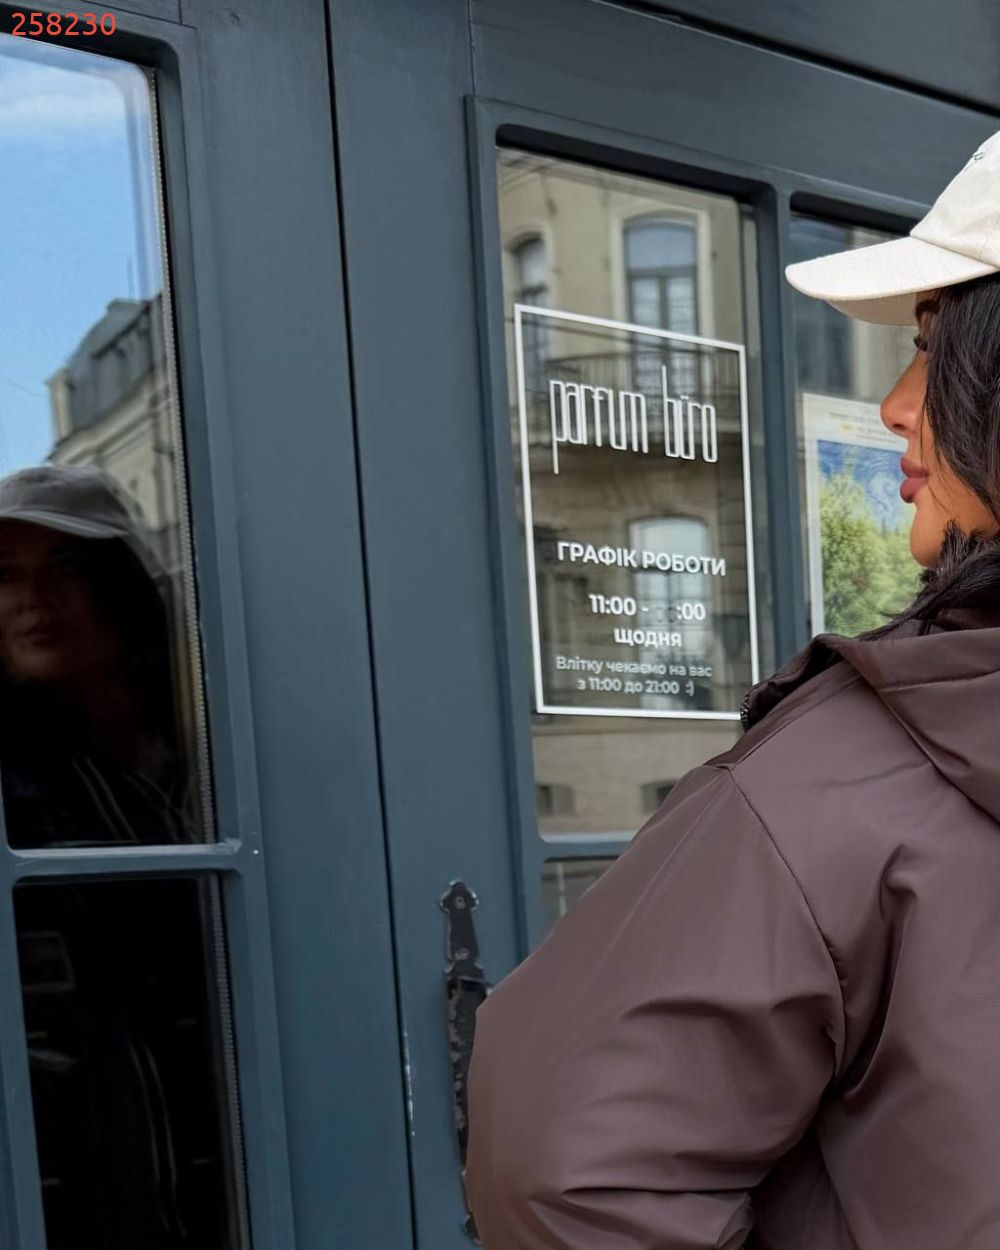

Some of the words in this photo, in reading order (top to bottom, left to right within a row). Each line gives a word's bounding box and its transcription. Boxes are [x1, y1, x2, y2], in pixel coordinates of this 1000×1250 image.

[549, 379, 649, 474] parfum
[557, 541, 638, 568] ГРАФІК
[642, 551, 727, 577] РОБОТИ
[588, 593, 637, 616] 11:00
[556, 655, 604, 675] Влітку
[606, 661, 667, 676] чекаємо
[669, 664, 687, 677] на
[689, 667, 714, 678] вас
[589, 677, 622, 692] 11:00
[624, 681, 643, 695] до
[645, 680, 681, 695] 21:00
